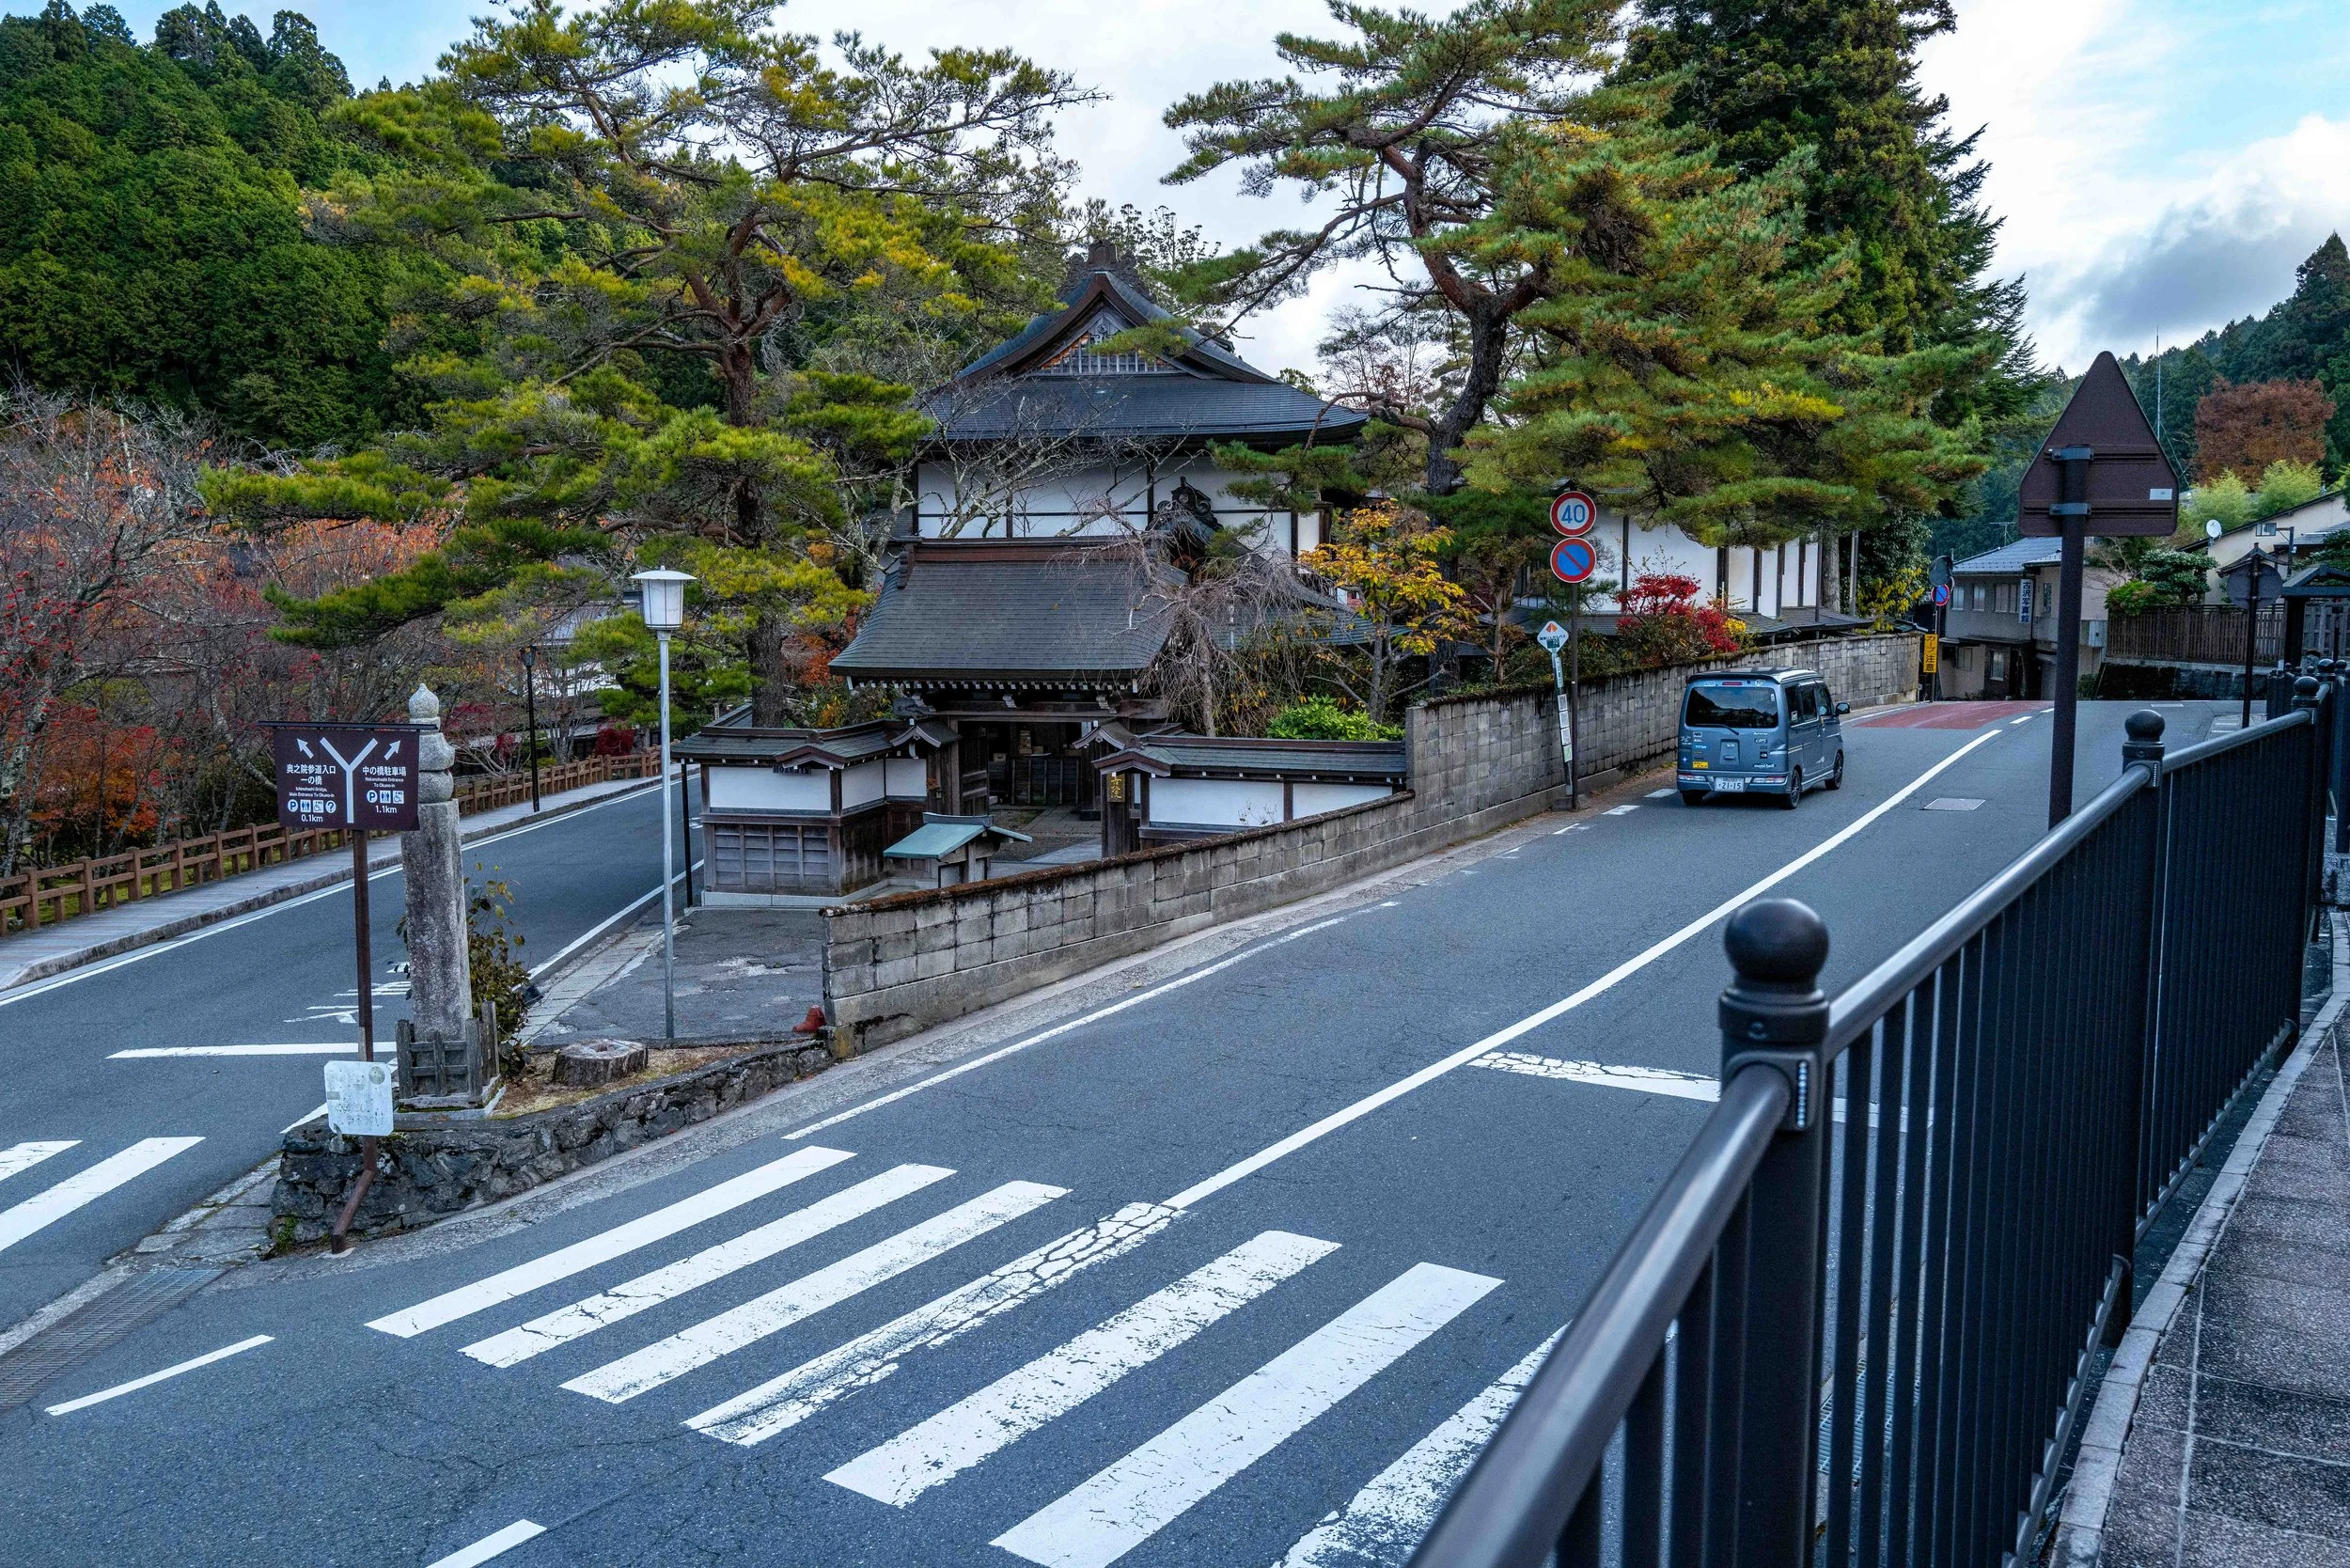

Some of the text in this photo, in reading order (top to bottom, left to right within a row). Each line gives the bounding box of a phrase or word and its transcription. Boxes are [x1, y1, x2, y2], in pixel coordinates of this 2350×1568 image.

[1561, 504, 1586, 524] 40
[286, 763, 337, 775] 奥之院参道入口
[362, 765, 407, 776] 中の橋駐車場
[300, 775, 322, 786] 一の橋
[375, 805, 398, 814] 1.1km
[301, 814, 323, 823] 0.1km
